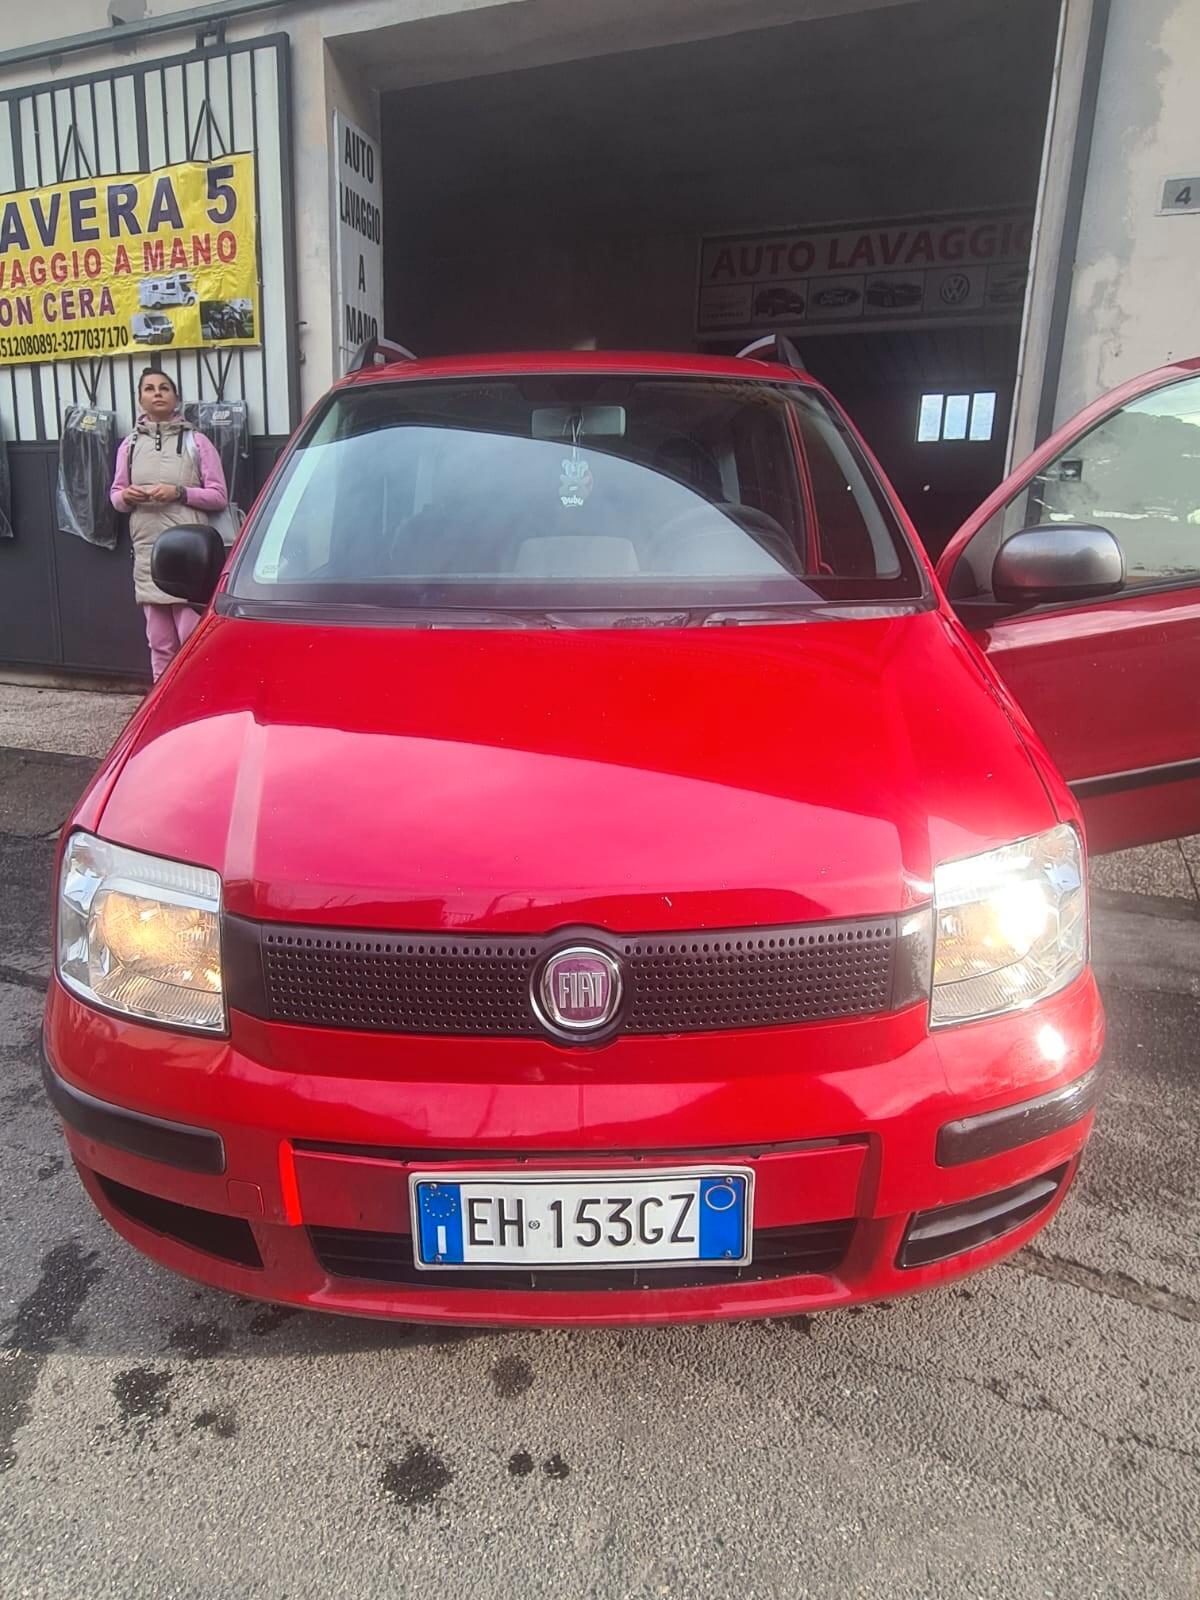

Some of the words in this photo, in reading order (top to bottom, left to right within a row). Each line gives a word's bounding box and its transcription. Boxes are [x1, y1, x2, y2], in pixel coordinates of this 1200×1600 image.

[345, 127, 374, 184] AUTO
[207, 164, 237, 224] 5
[339, 182, 381, 245] LAVAGGIO
[1175, 186, 1192, 205] 4
[114, 244, 132, 275] A
[143, 230, 237, 272] MANO
[711, 241, 815, 280] AUTO
[358, 254, 366, 293] A
[43, 287, 116, 322] CERA
[0, 326, 128, 357] 512080892-3277037170
[559, 971, 606, 1009] FIAT
[467, 1197, 525, 1248] EH
[549, 1193, 696, 1249] 153GZ
